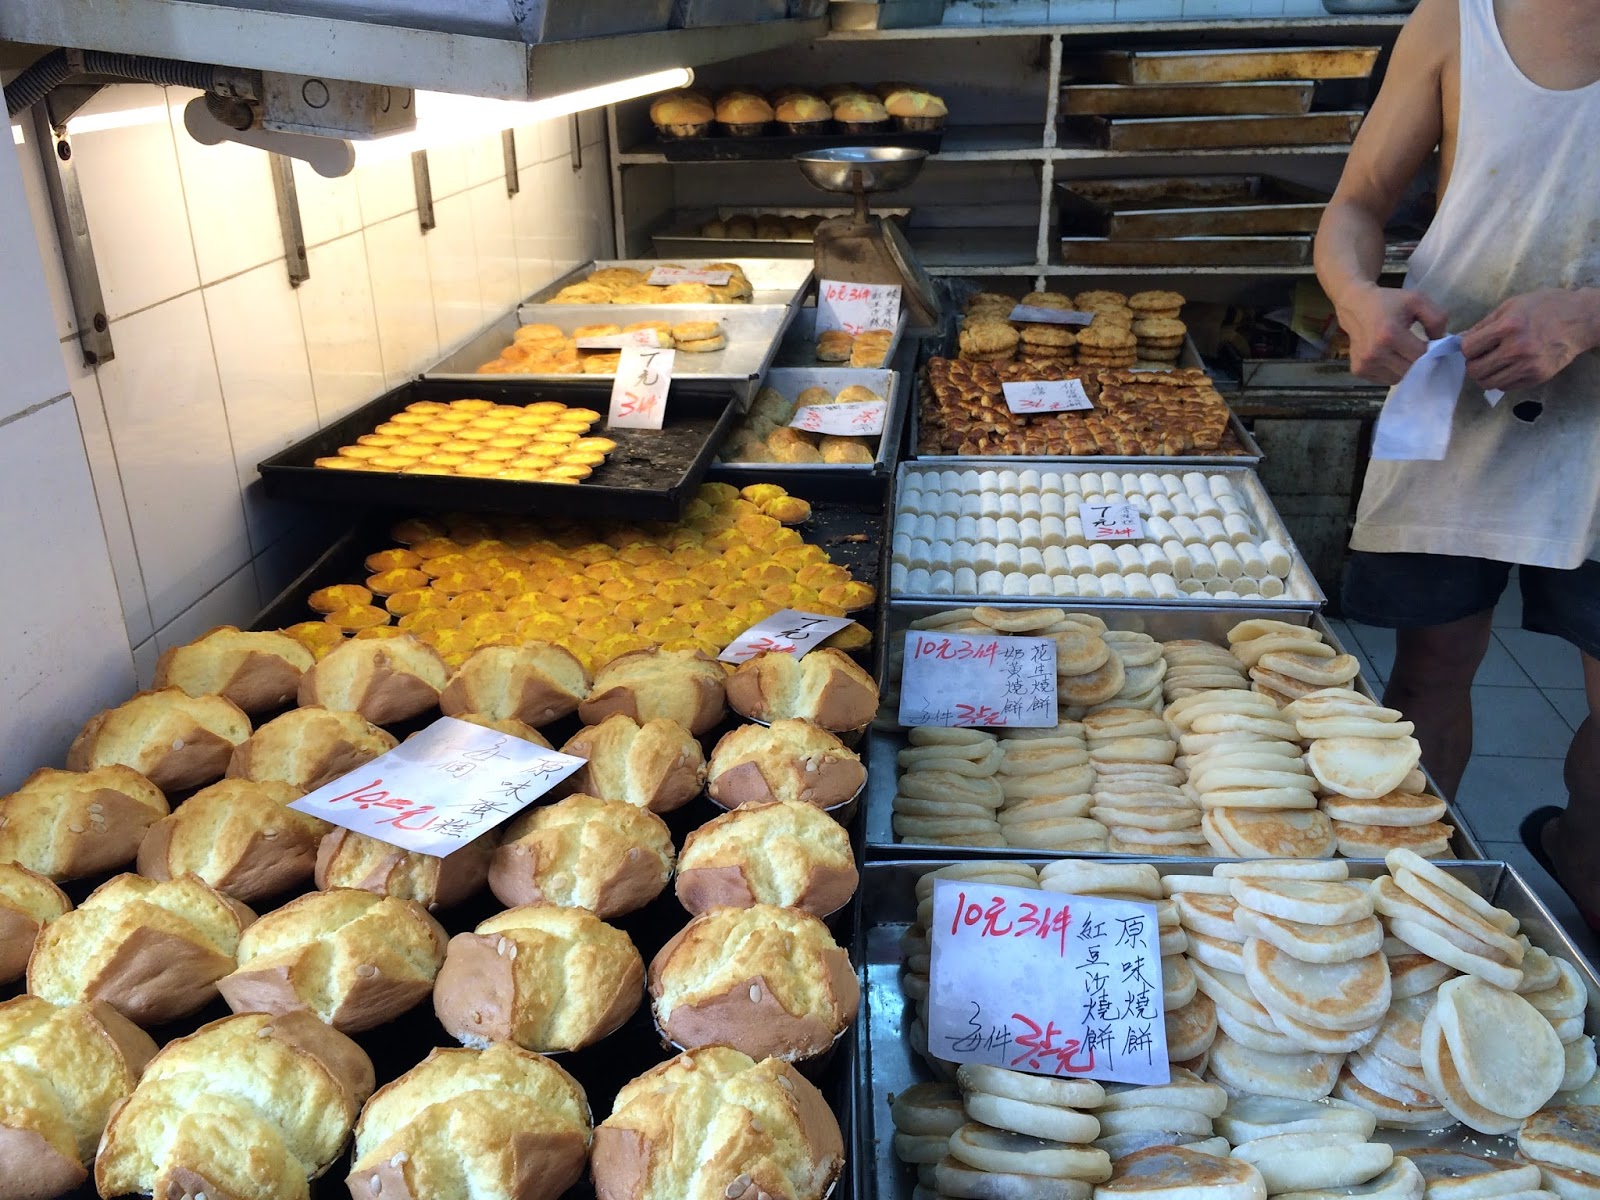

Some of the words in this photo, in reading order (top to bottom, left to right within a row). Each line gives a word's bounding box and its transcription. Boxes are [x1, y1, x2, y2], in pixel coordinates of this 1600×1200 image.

[914, 636, 999, 668] 10元3件
[951, 892, 1073, 958] 10元3件
[1114, 915, 1159, 1066] 原味燒餅
